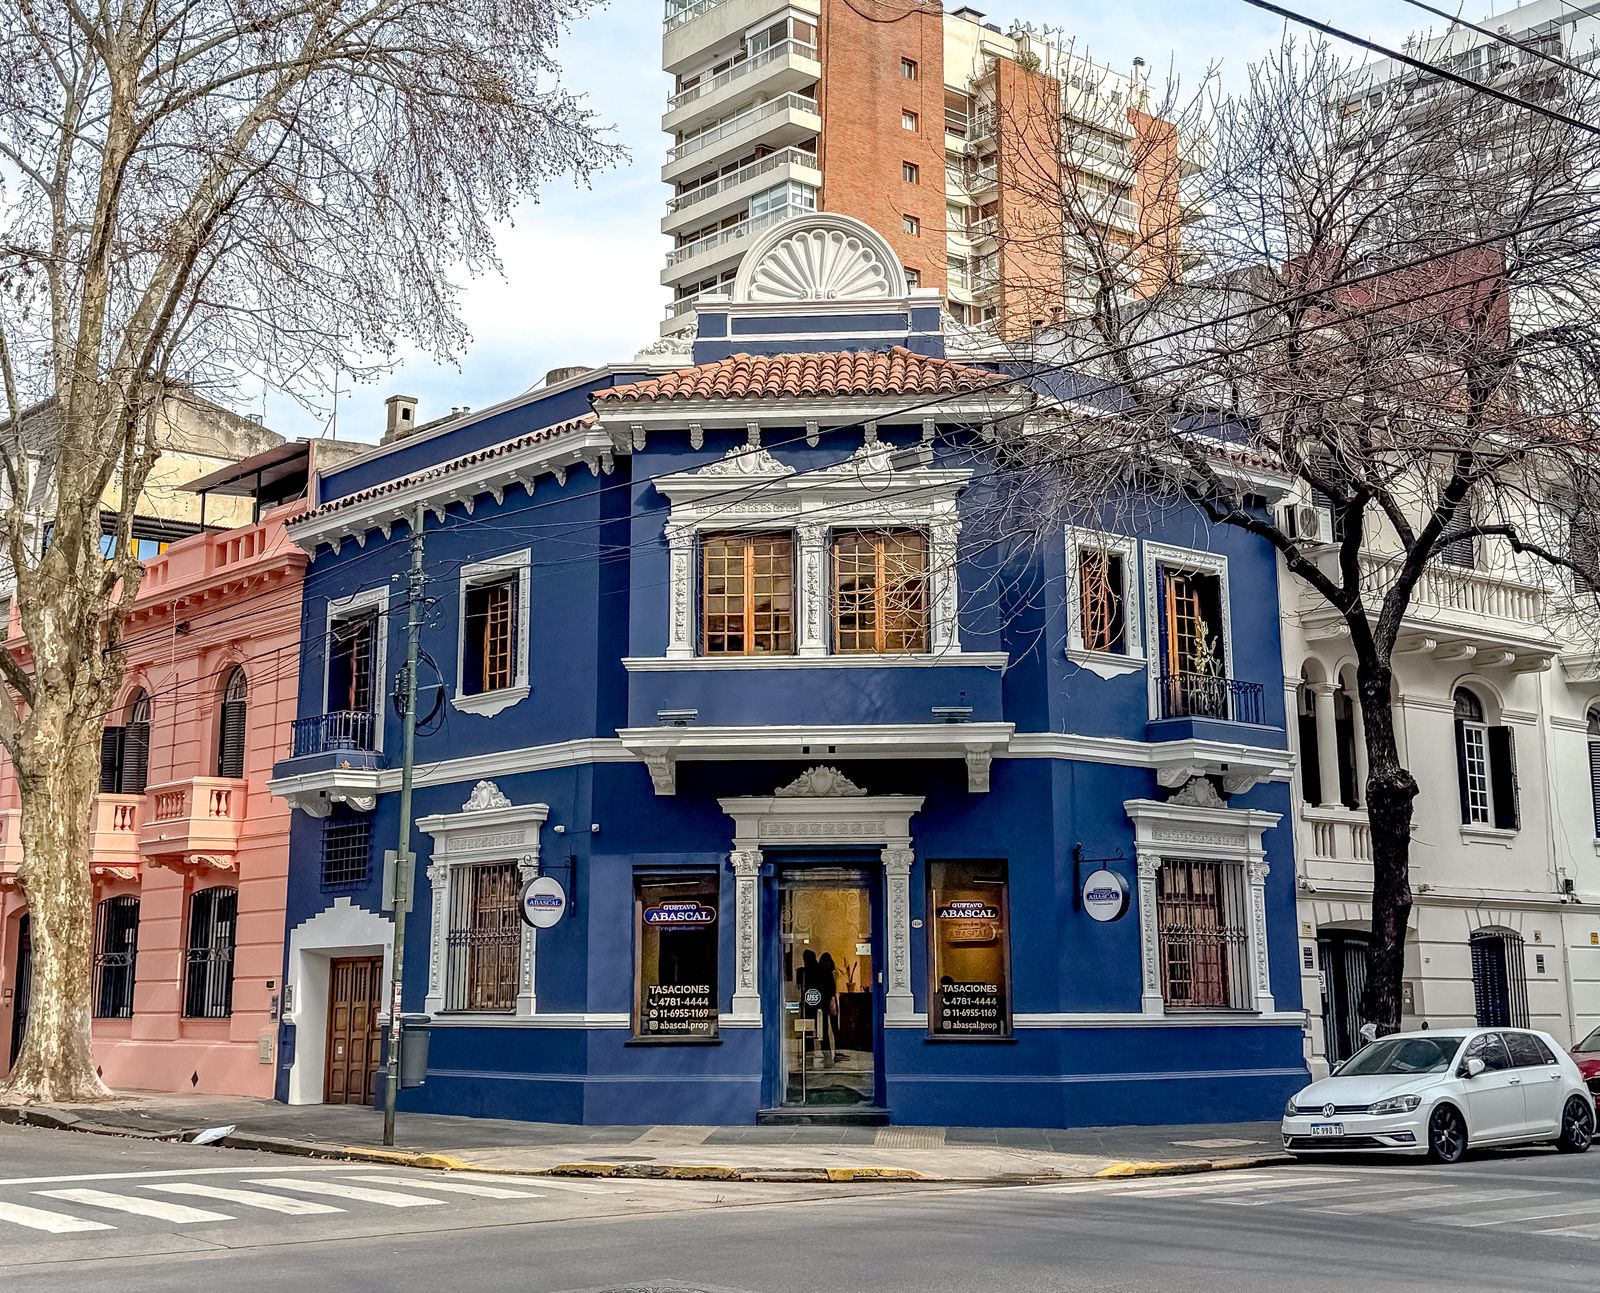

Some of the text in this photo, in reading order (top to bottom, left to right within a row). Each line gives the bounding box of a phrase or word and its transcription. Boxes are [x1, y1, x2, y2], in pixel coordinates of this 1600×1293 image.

[650, 911, 711, 921] ABASCAL
[940, 909, 996, 918] ABASCAL
[649, 985, 710, 994] TASACIONES
[942, 984, 998, 992] TASACIONES
[658, 997, 709, 1006] 4781-4444
[950, 997, 997, 1005] 4781-4444
[660, 1009, 709, 1018] 11-6955-1169
[952, 1009, 997, 1017] 11-6955-1169
[660, 1020, 709, 1031] abascal.prop
[952, 1020, 998, 1030] abascal.prop
